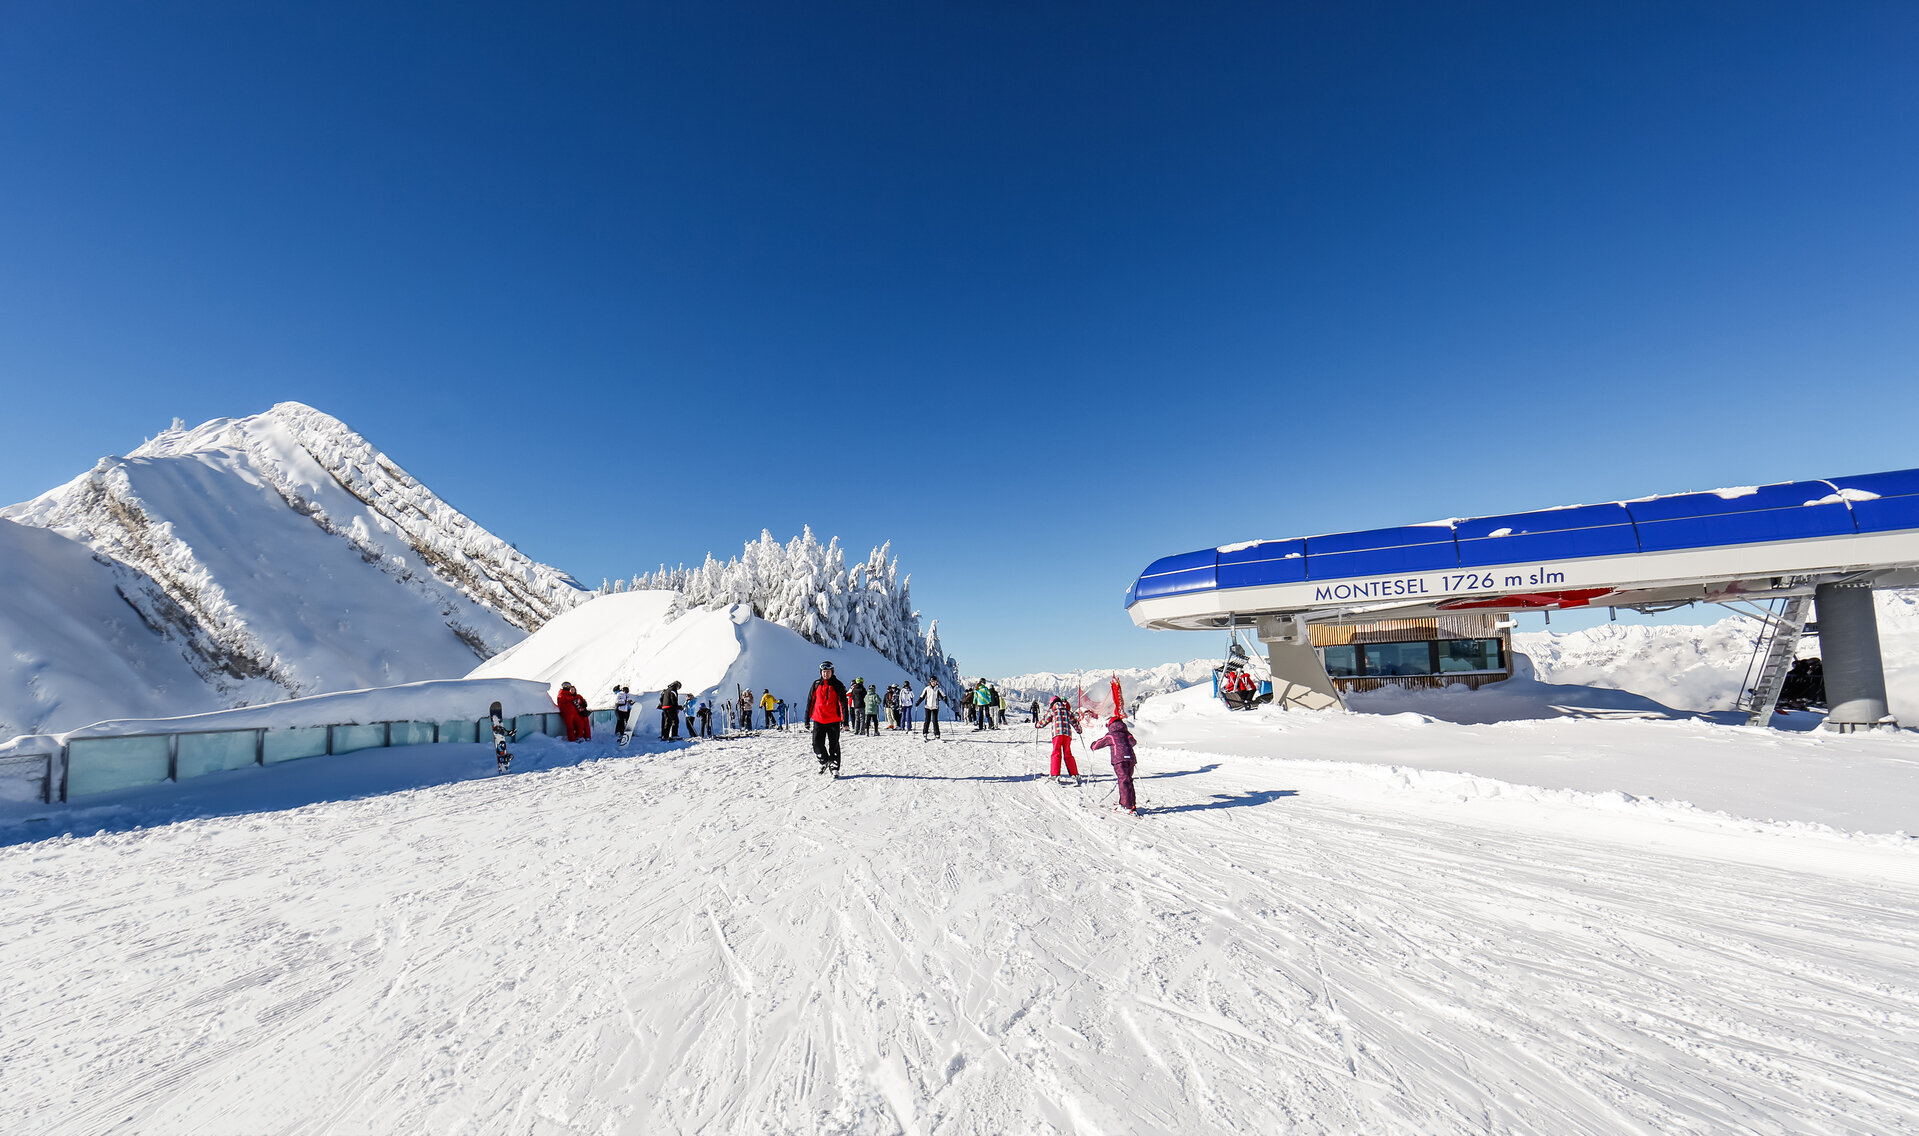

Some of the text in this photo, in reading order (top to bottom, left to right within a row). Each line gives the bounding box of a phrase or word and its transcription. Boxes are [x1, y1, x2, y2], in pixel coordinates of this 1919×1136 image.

[1315, 567, 1565, 601] MONTESEL 1726 m slm
